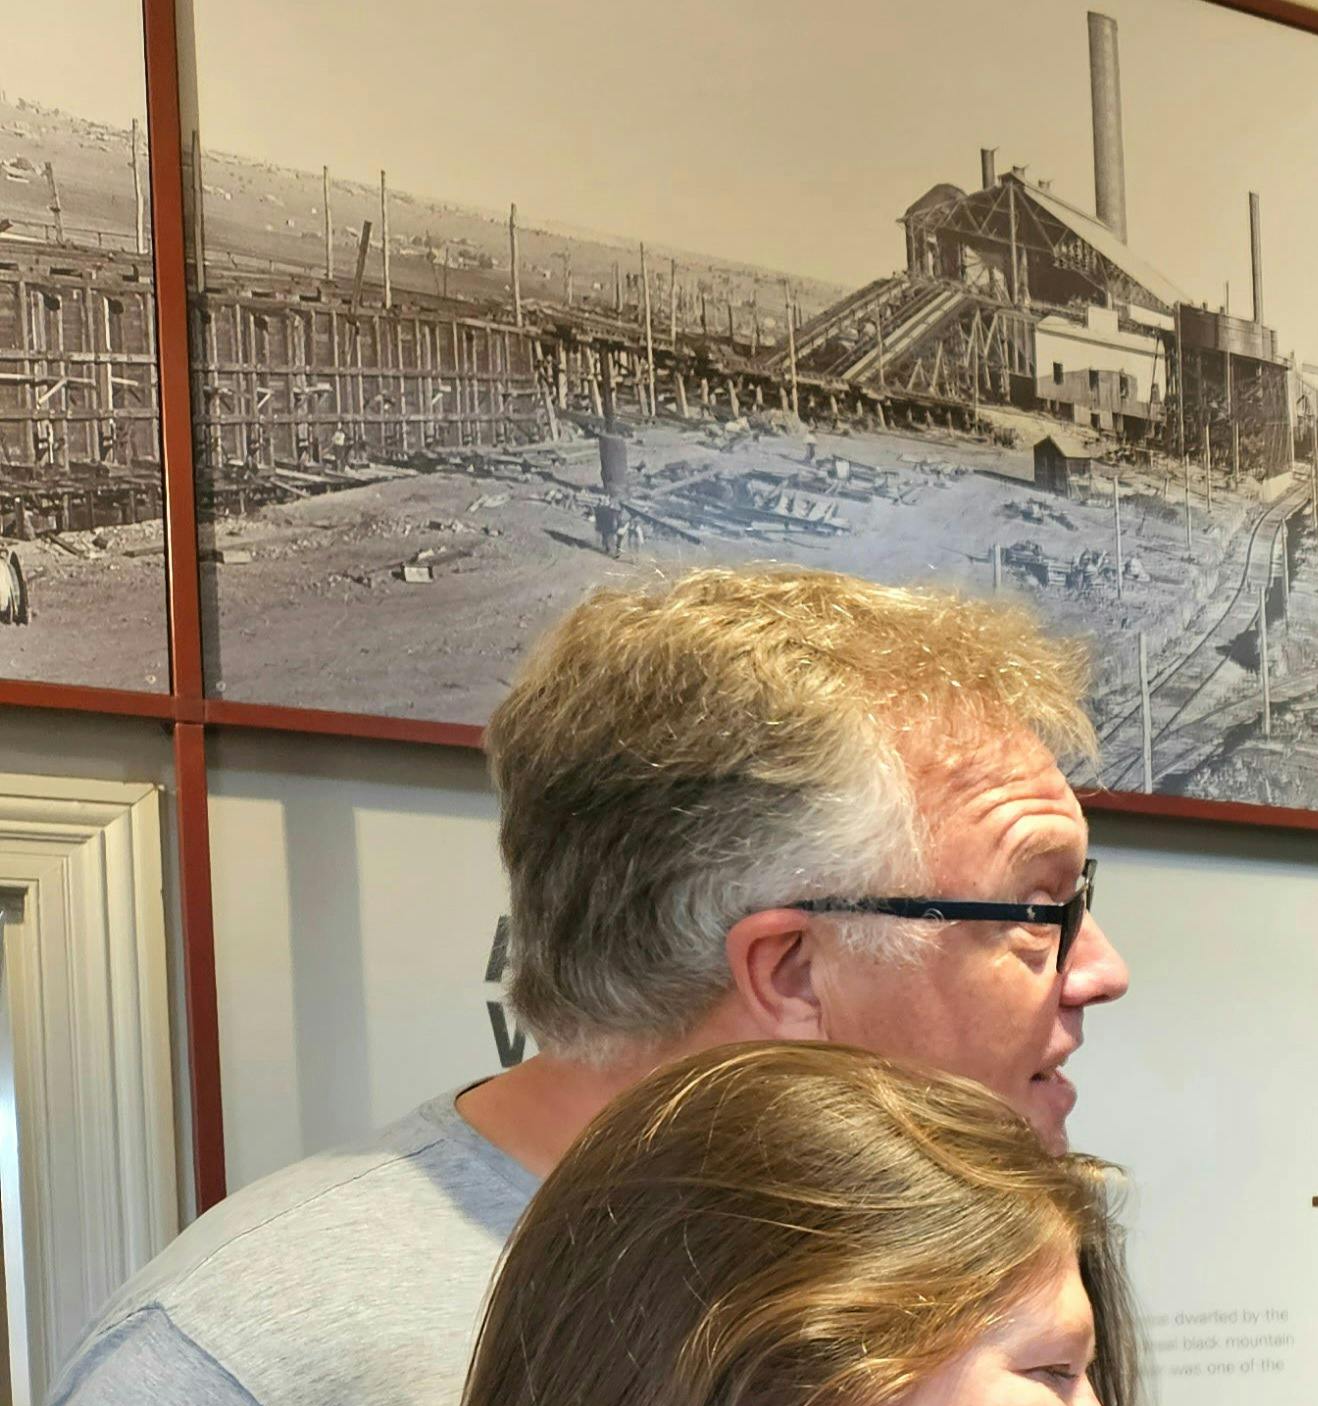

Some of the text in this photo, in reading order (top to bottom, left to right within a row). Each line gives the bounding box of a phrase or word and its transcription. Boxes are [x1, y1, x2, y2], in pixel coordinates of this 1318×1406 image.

[1243, 1309, 1259, 1324] by
[1266, 1308, 1289, 1322] the
[1183, 1335, 1218, 1350] black
[1225, 1333, 1295, 1347] mountain
[1207, 1363, 1235, 1375] one
[1240, 1358, 1255, 1373] of
[1261, 1358, 1285, 1372] the
